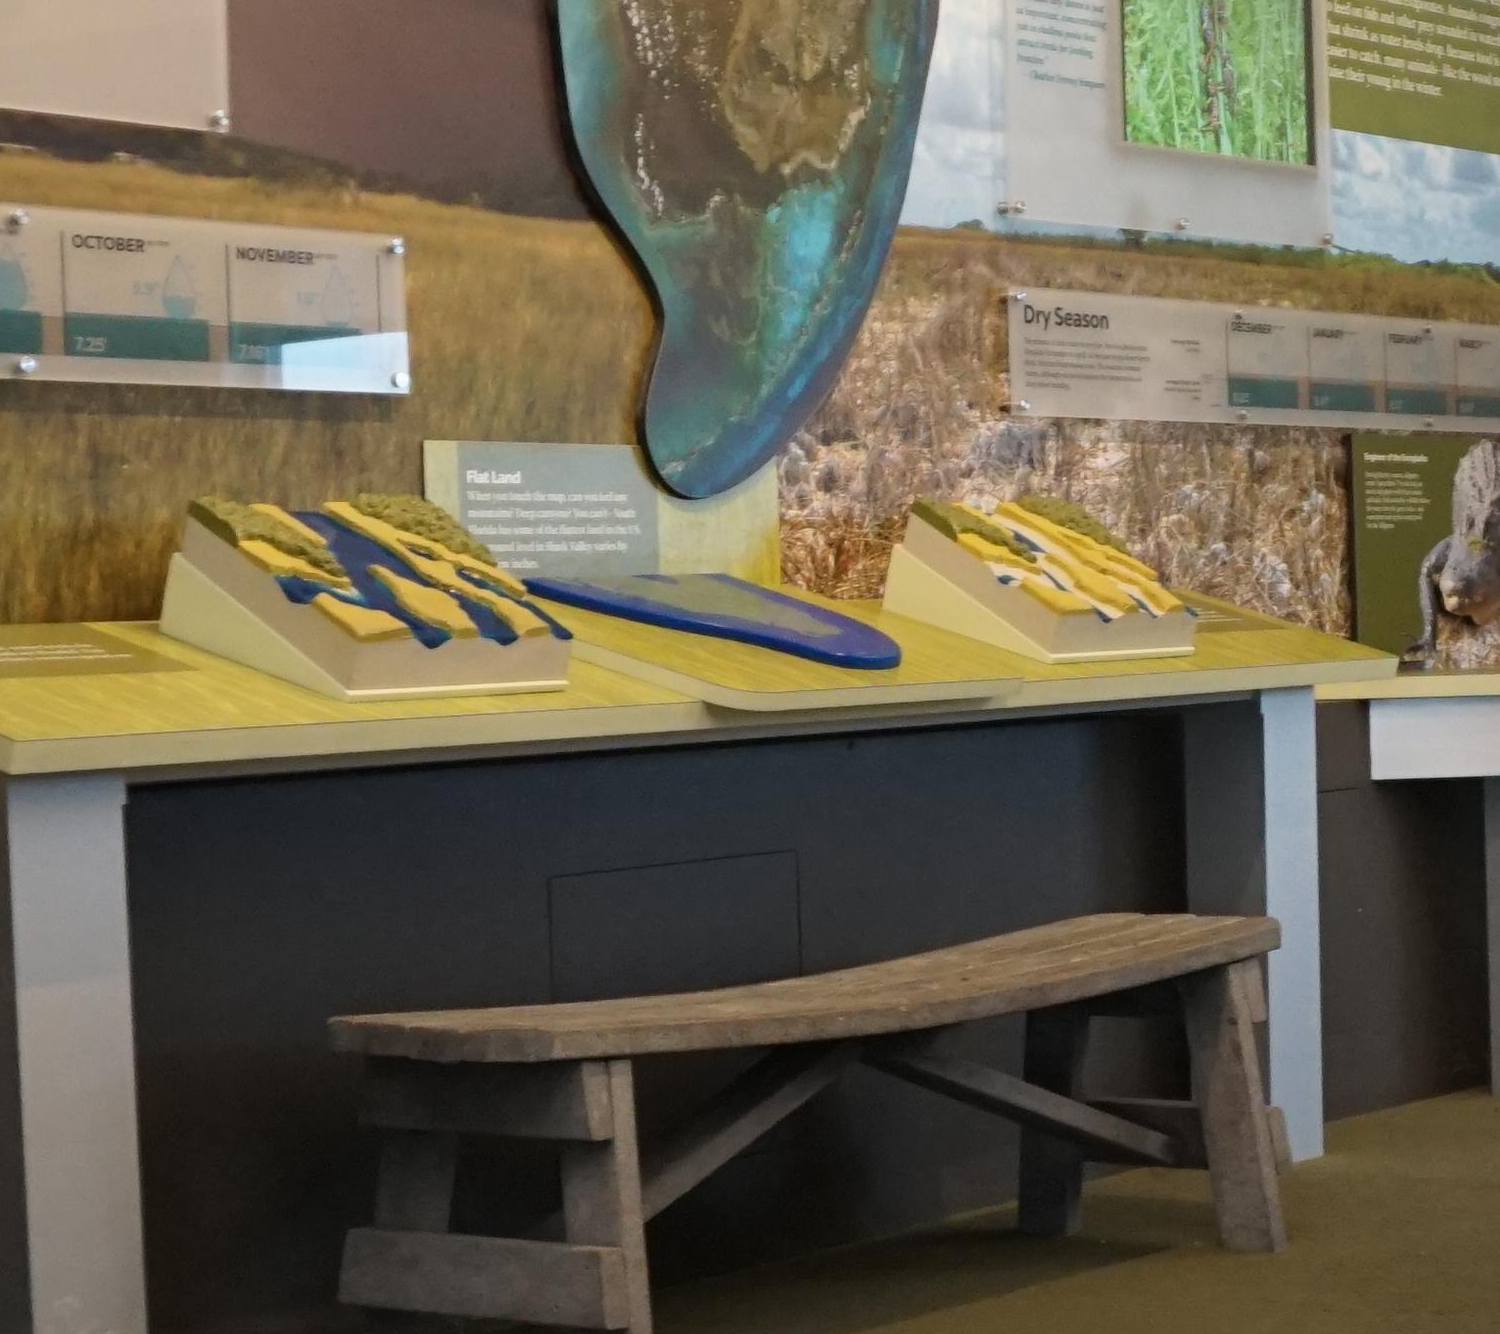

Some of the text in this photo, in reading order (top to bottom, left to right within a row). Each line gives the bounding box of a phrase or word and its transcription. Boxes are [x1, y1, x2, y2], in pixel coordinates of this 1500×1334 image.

[71, 234, 145, 253] OCTOBER
[235, 246, 315, 265] NOVEMBER
[1023, 304, 1110, 331] Dry Season
[466, 470, 521, 484] Flat Land
